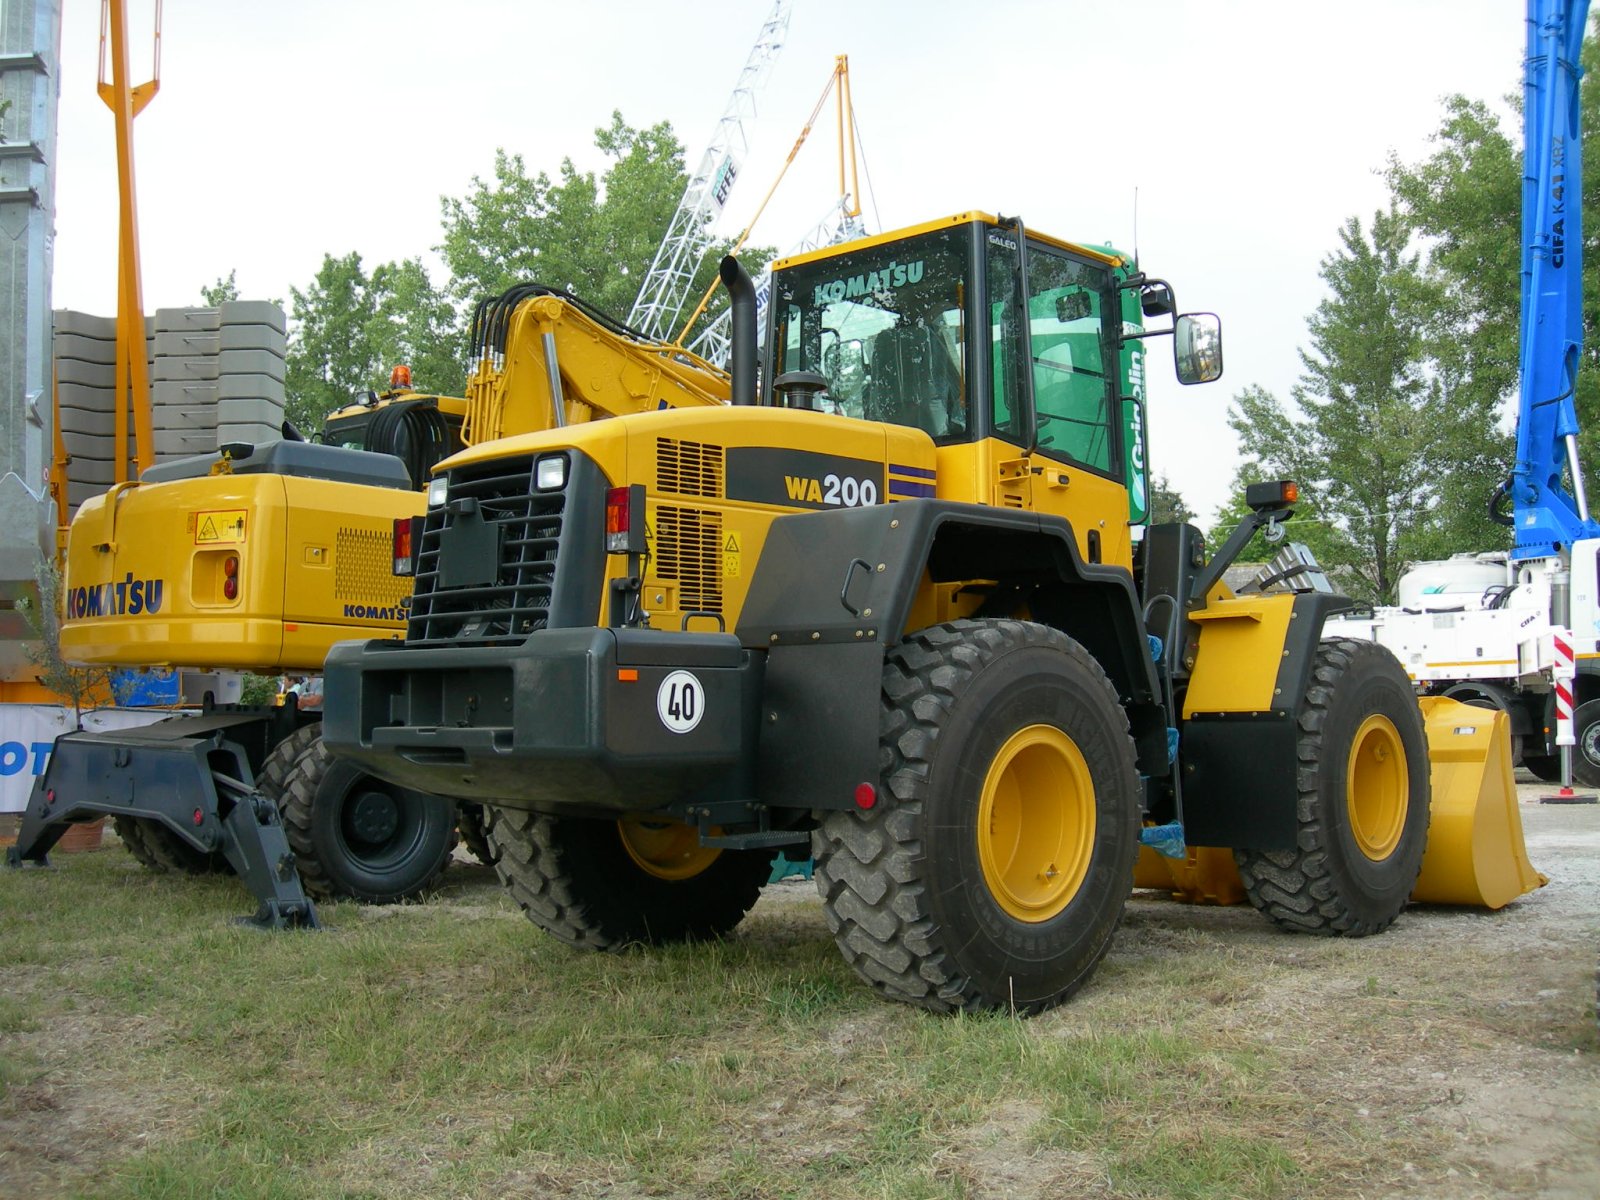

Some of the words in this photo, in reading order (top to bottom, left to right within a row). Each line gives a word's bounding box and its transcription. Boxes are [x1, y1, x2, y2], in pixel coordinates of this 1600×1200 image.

[716, 162, 737, 205] EFFE
[989, 235, 1016, 250] GALEO
[1552, 218, 1564, 269] CIFA
[815, 261, 923, 304] KOMATSU
[785, 474, 877, 507] WA200
[67, 573, 163, 619] KOMATSU
[1520, 615, 1535, 628] CIFA
[668, 683, 694, 721] 40
